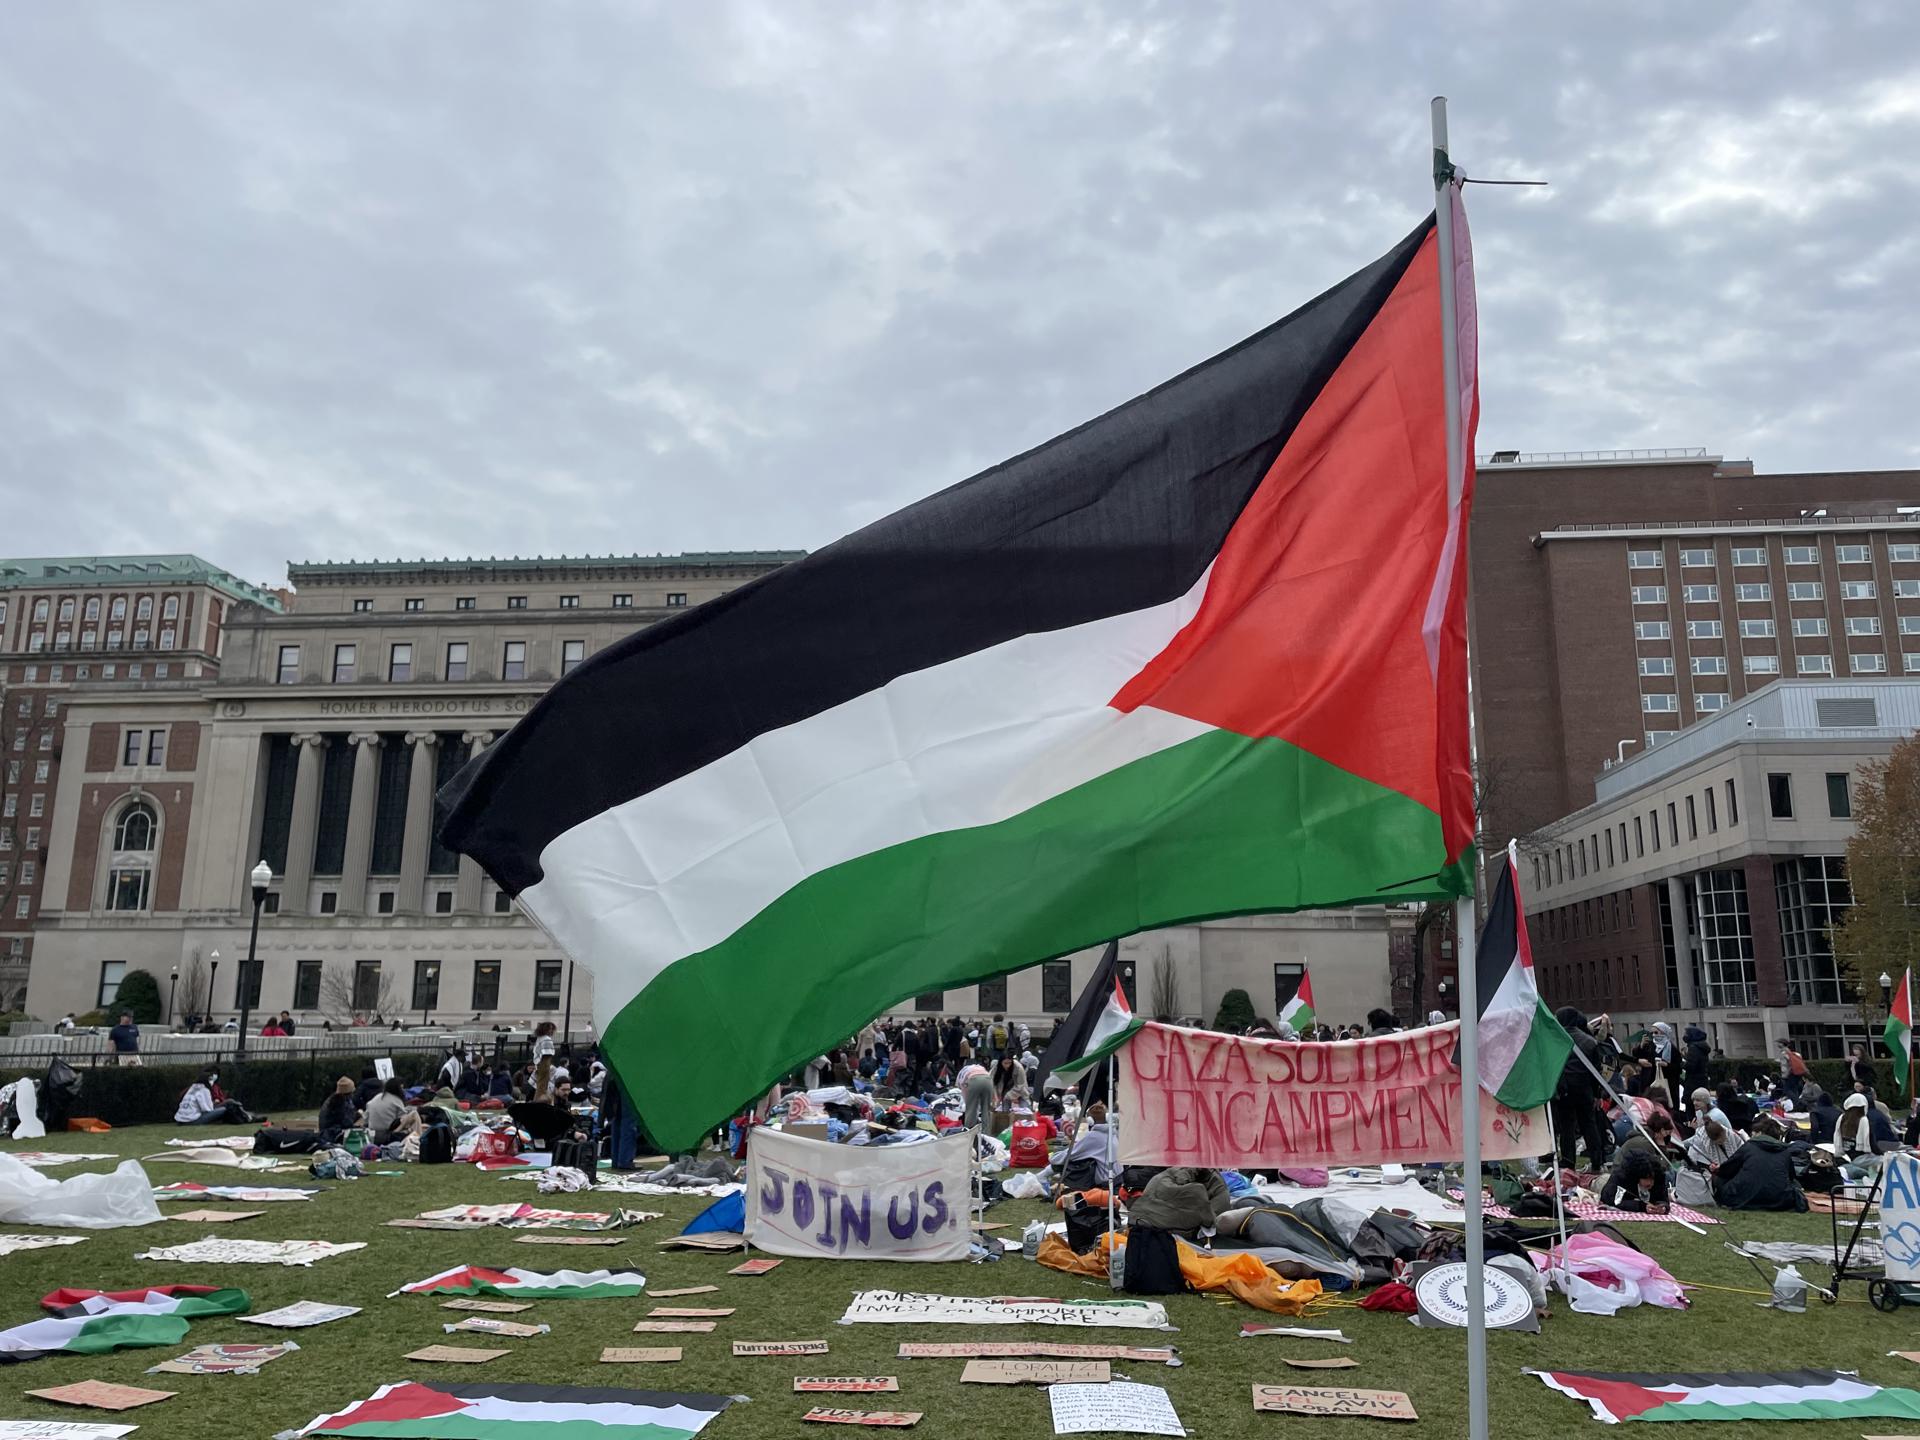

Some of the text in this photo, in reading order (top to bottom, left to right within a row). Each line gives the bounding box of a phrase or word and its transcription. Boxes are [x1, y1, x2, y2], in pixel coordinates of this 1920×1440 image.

[320, 702, 377, 714] HOMER
[389, 700, 491, 714] HERODOTUS
[1131, 1025, 1461, 1085] GAZA SOLIDAR
[761, 1166, 957, 1254] JOIN US.
[735, 1342, 829, 1352] TUITION STRIKE
[977, 1361, 1109, 1372] GLOBALIZE
[1260, 1387, 1368, 1400] CANCEL
[1263, 1401, 1360, 1413] GLOBAL
[1334, 1400, 1397, 1409] AVIV
[812, 1407, 878, 1418] JUST
[5, 1422, 111, 1432] SHAME
